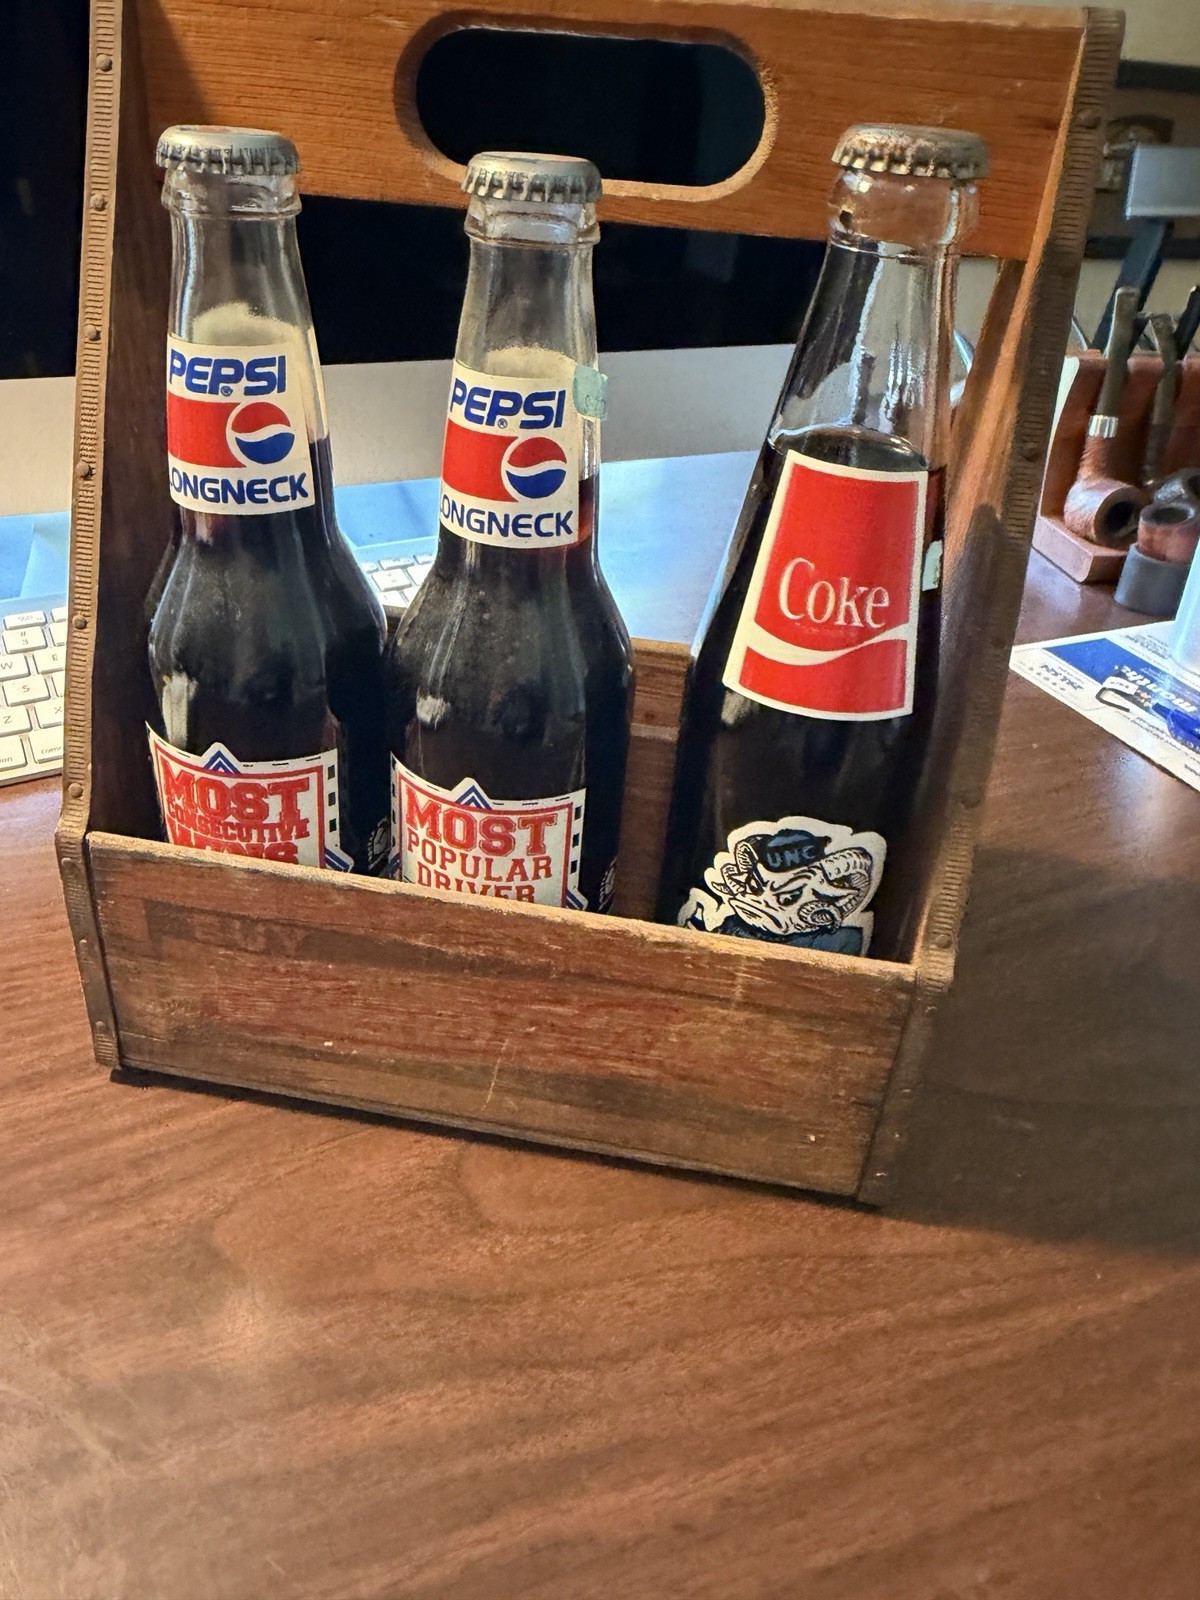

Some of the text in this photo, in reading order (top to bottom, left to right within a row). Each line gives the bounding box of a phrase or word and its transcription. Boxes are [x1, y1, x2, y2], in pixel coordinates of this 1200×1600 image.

[169, 348, 286, 396] PEPSI
[450, 377, 566, 429] PEPSI
[170, 466, 309, 504] ONGNECK
[440, 493, 574, 538] ONGNECK
[778, 556, 890, 629] Coke
[21, 684, 31, 693] S
[3, 715, 13, 724] Z
[160, 755, 309, 824] MOST
[406, 784, 557, 857] MOST
[407, 826, 552, 883] POPULAR
[766, 845, 817, 869] UNC
